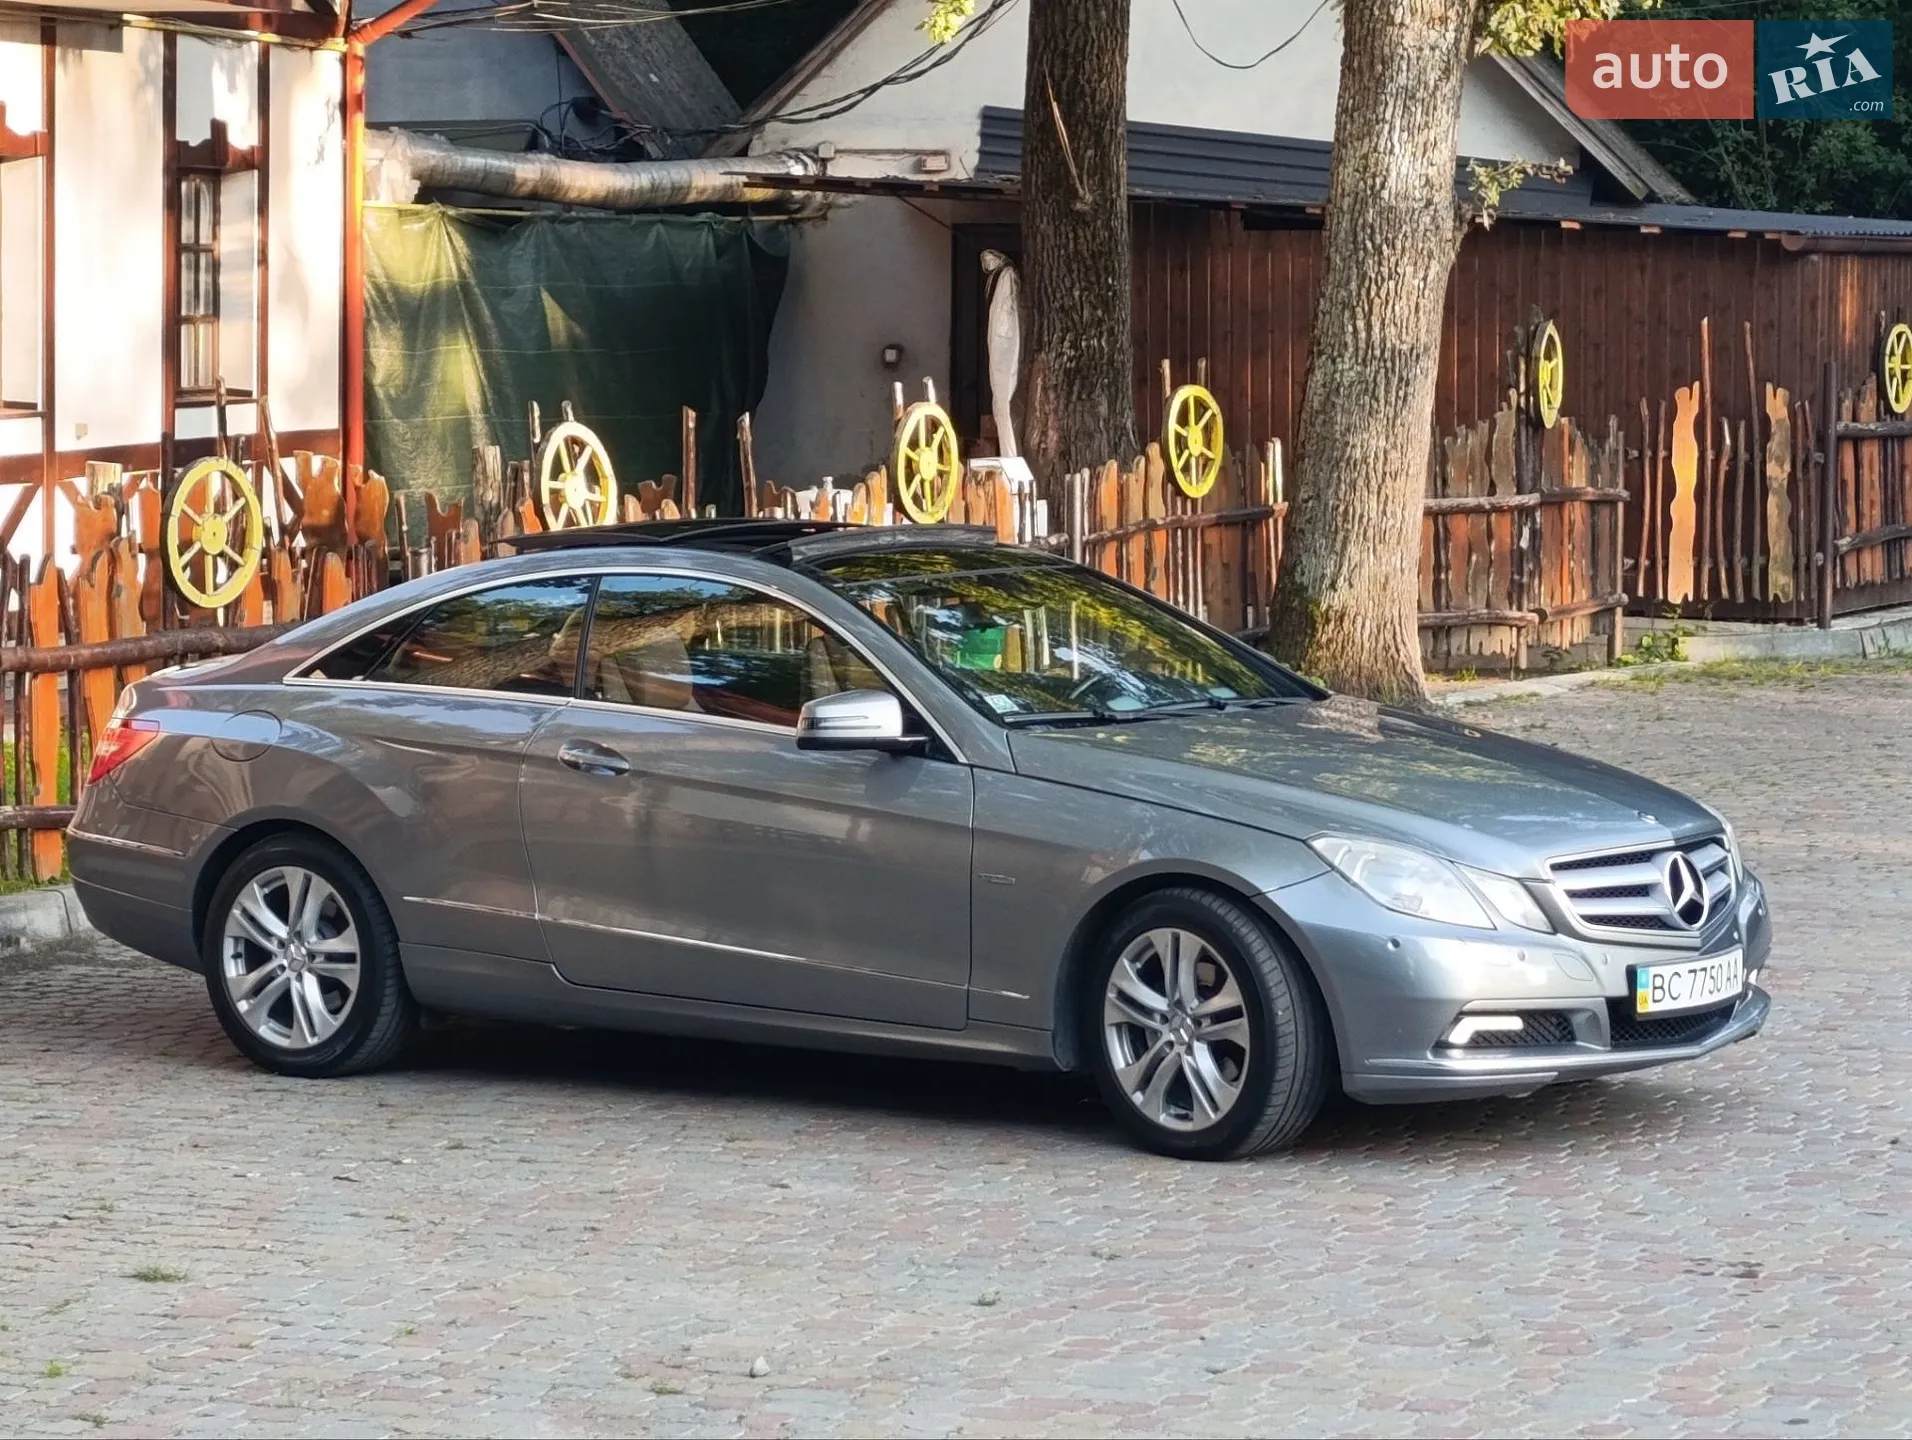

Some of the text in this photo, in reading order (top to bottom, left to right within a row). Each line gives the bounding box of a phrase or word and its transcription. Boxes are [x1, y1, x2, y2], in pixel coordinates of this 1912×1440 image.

[1652, 957, 1739, 1003] BC 7750 AA
[1638, 995, 1648, 1006] UA
